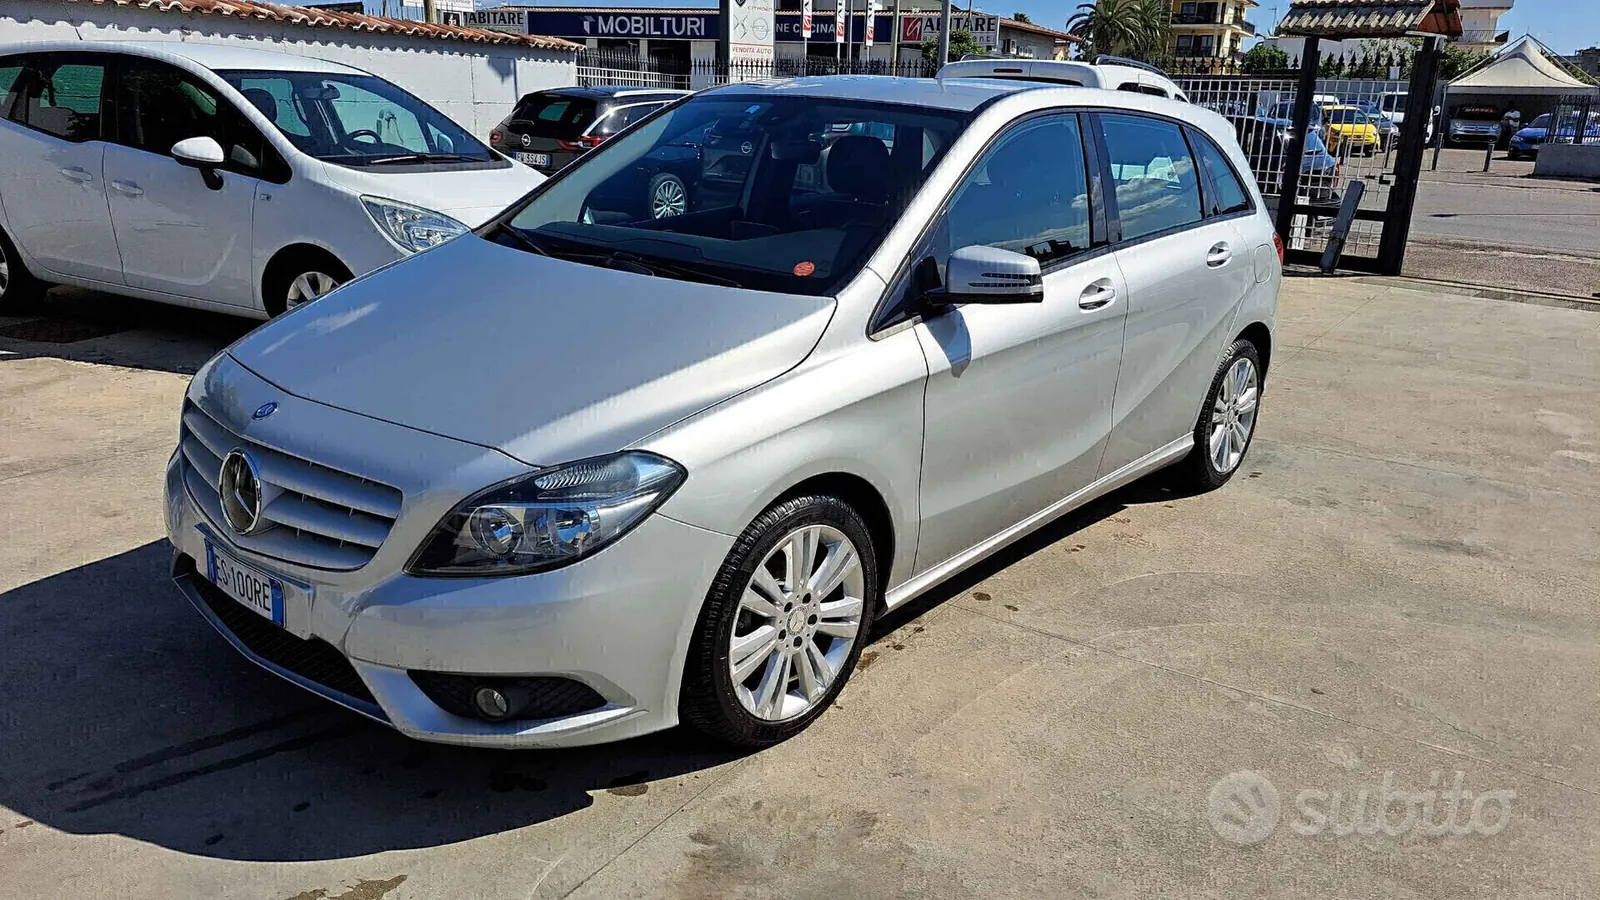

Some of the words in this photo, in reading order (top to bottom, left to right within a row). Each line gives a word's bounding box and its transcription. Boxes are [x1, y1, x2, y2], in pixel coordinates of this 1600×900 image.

[468, 12, 524, 25] ABITARE
[598, 15, 705, 36] MOBILTURI
[793, 23, 835, 34] CCINA
